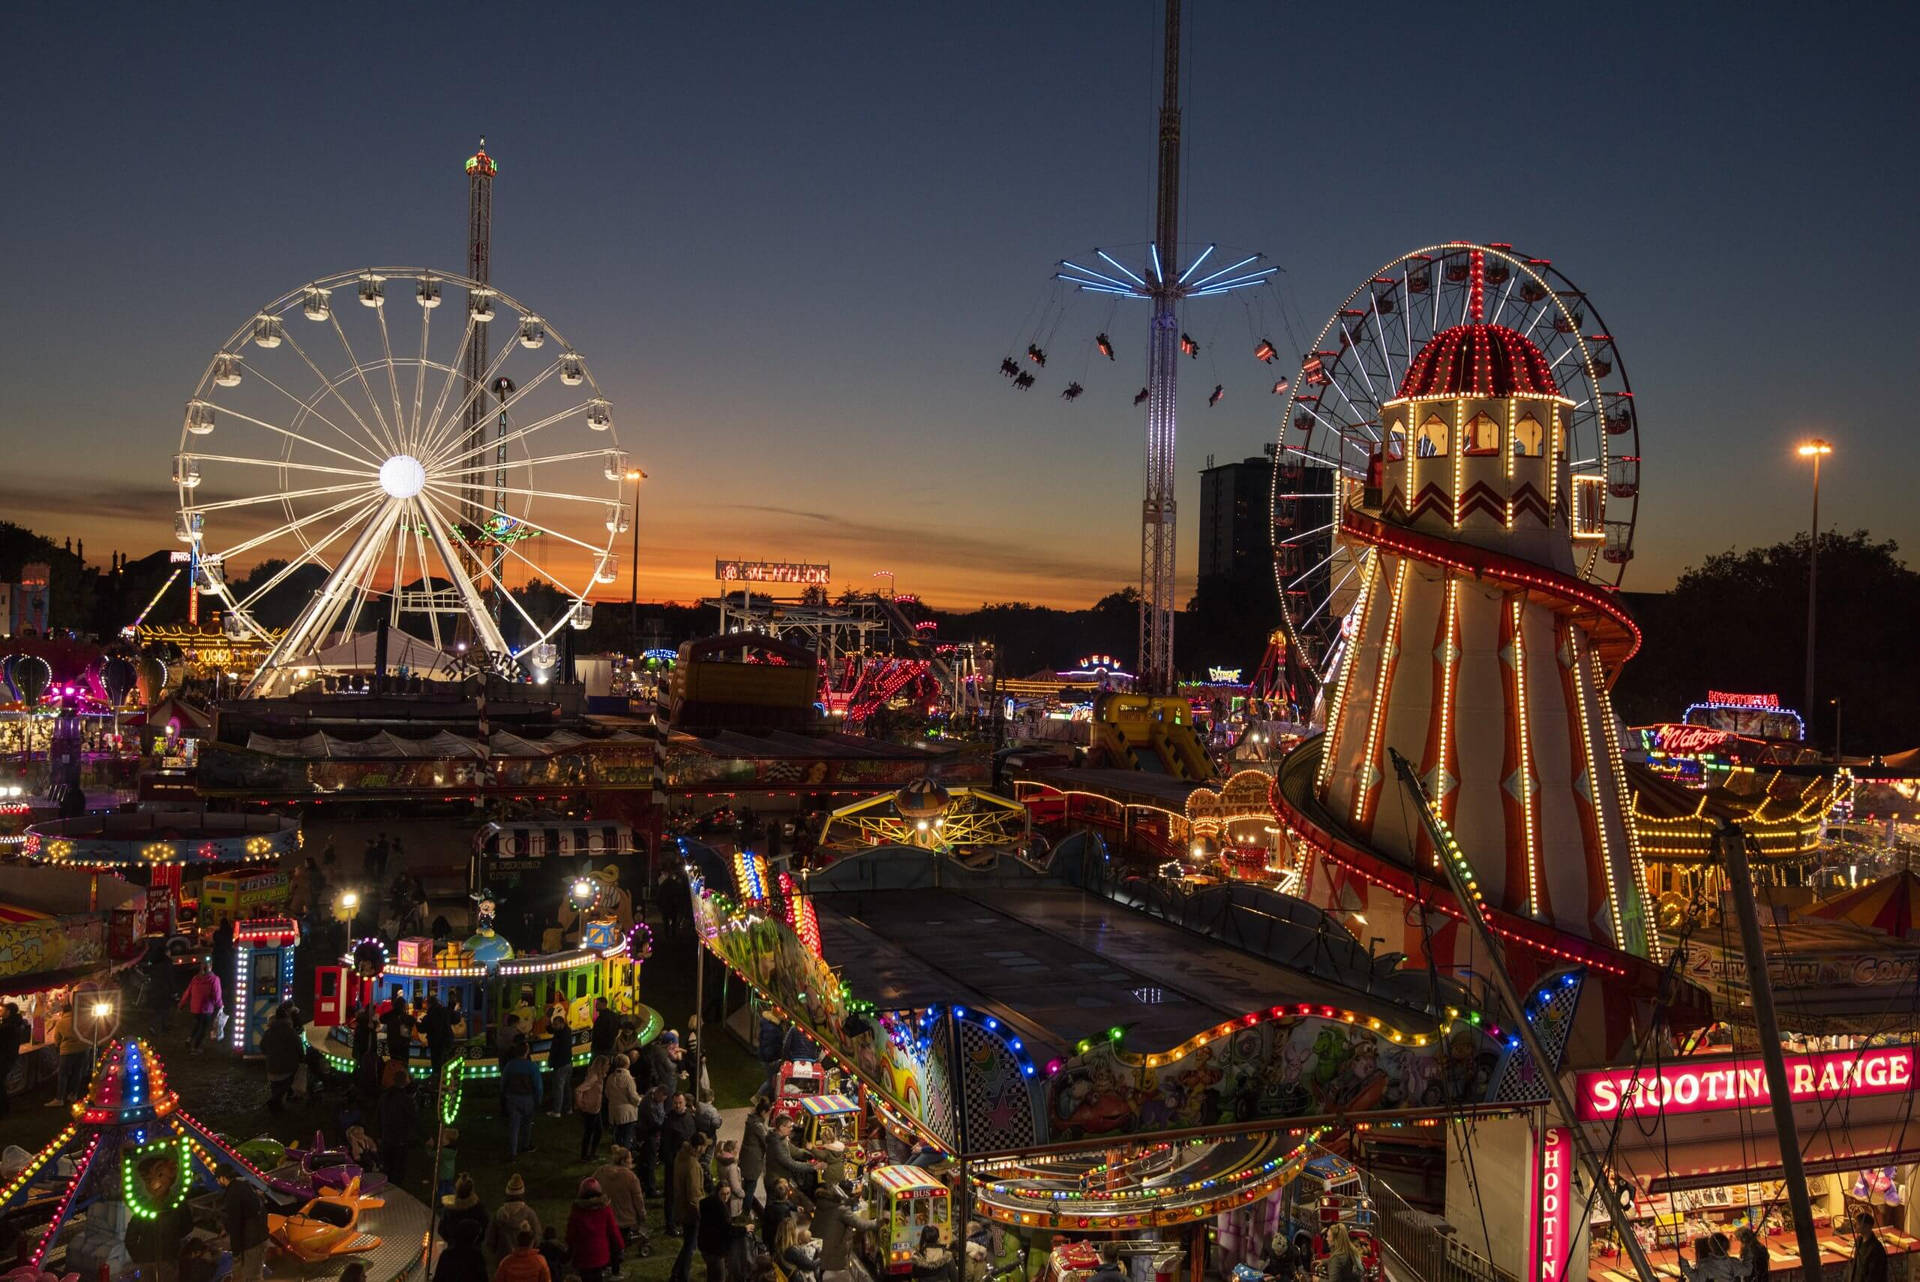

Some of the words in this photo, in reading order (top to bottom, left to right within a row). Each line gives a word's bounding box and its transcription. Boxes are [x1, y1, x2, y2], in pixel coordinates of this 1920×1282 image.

[1708, 690, 1779, 707] HYSTERIA
[1662, 727, 1728, 751] Waltzer
[1793, 1055, 1911, 1094] RANGE
[913, 1189, 930, 1198] BUS
